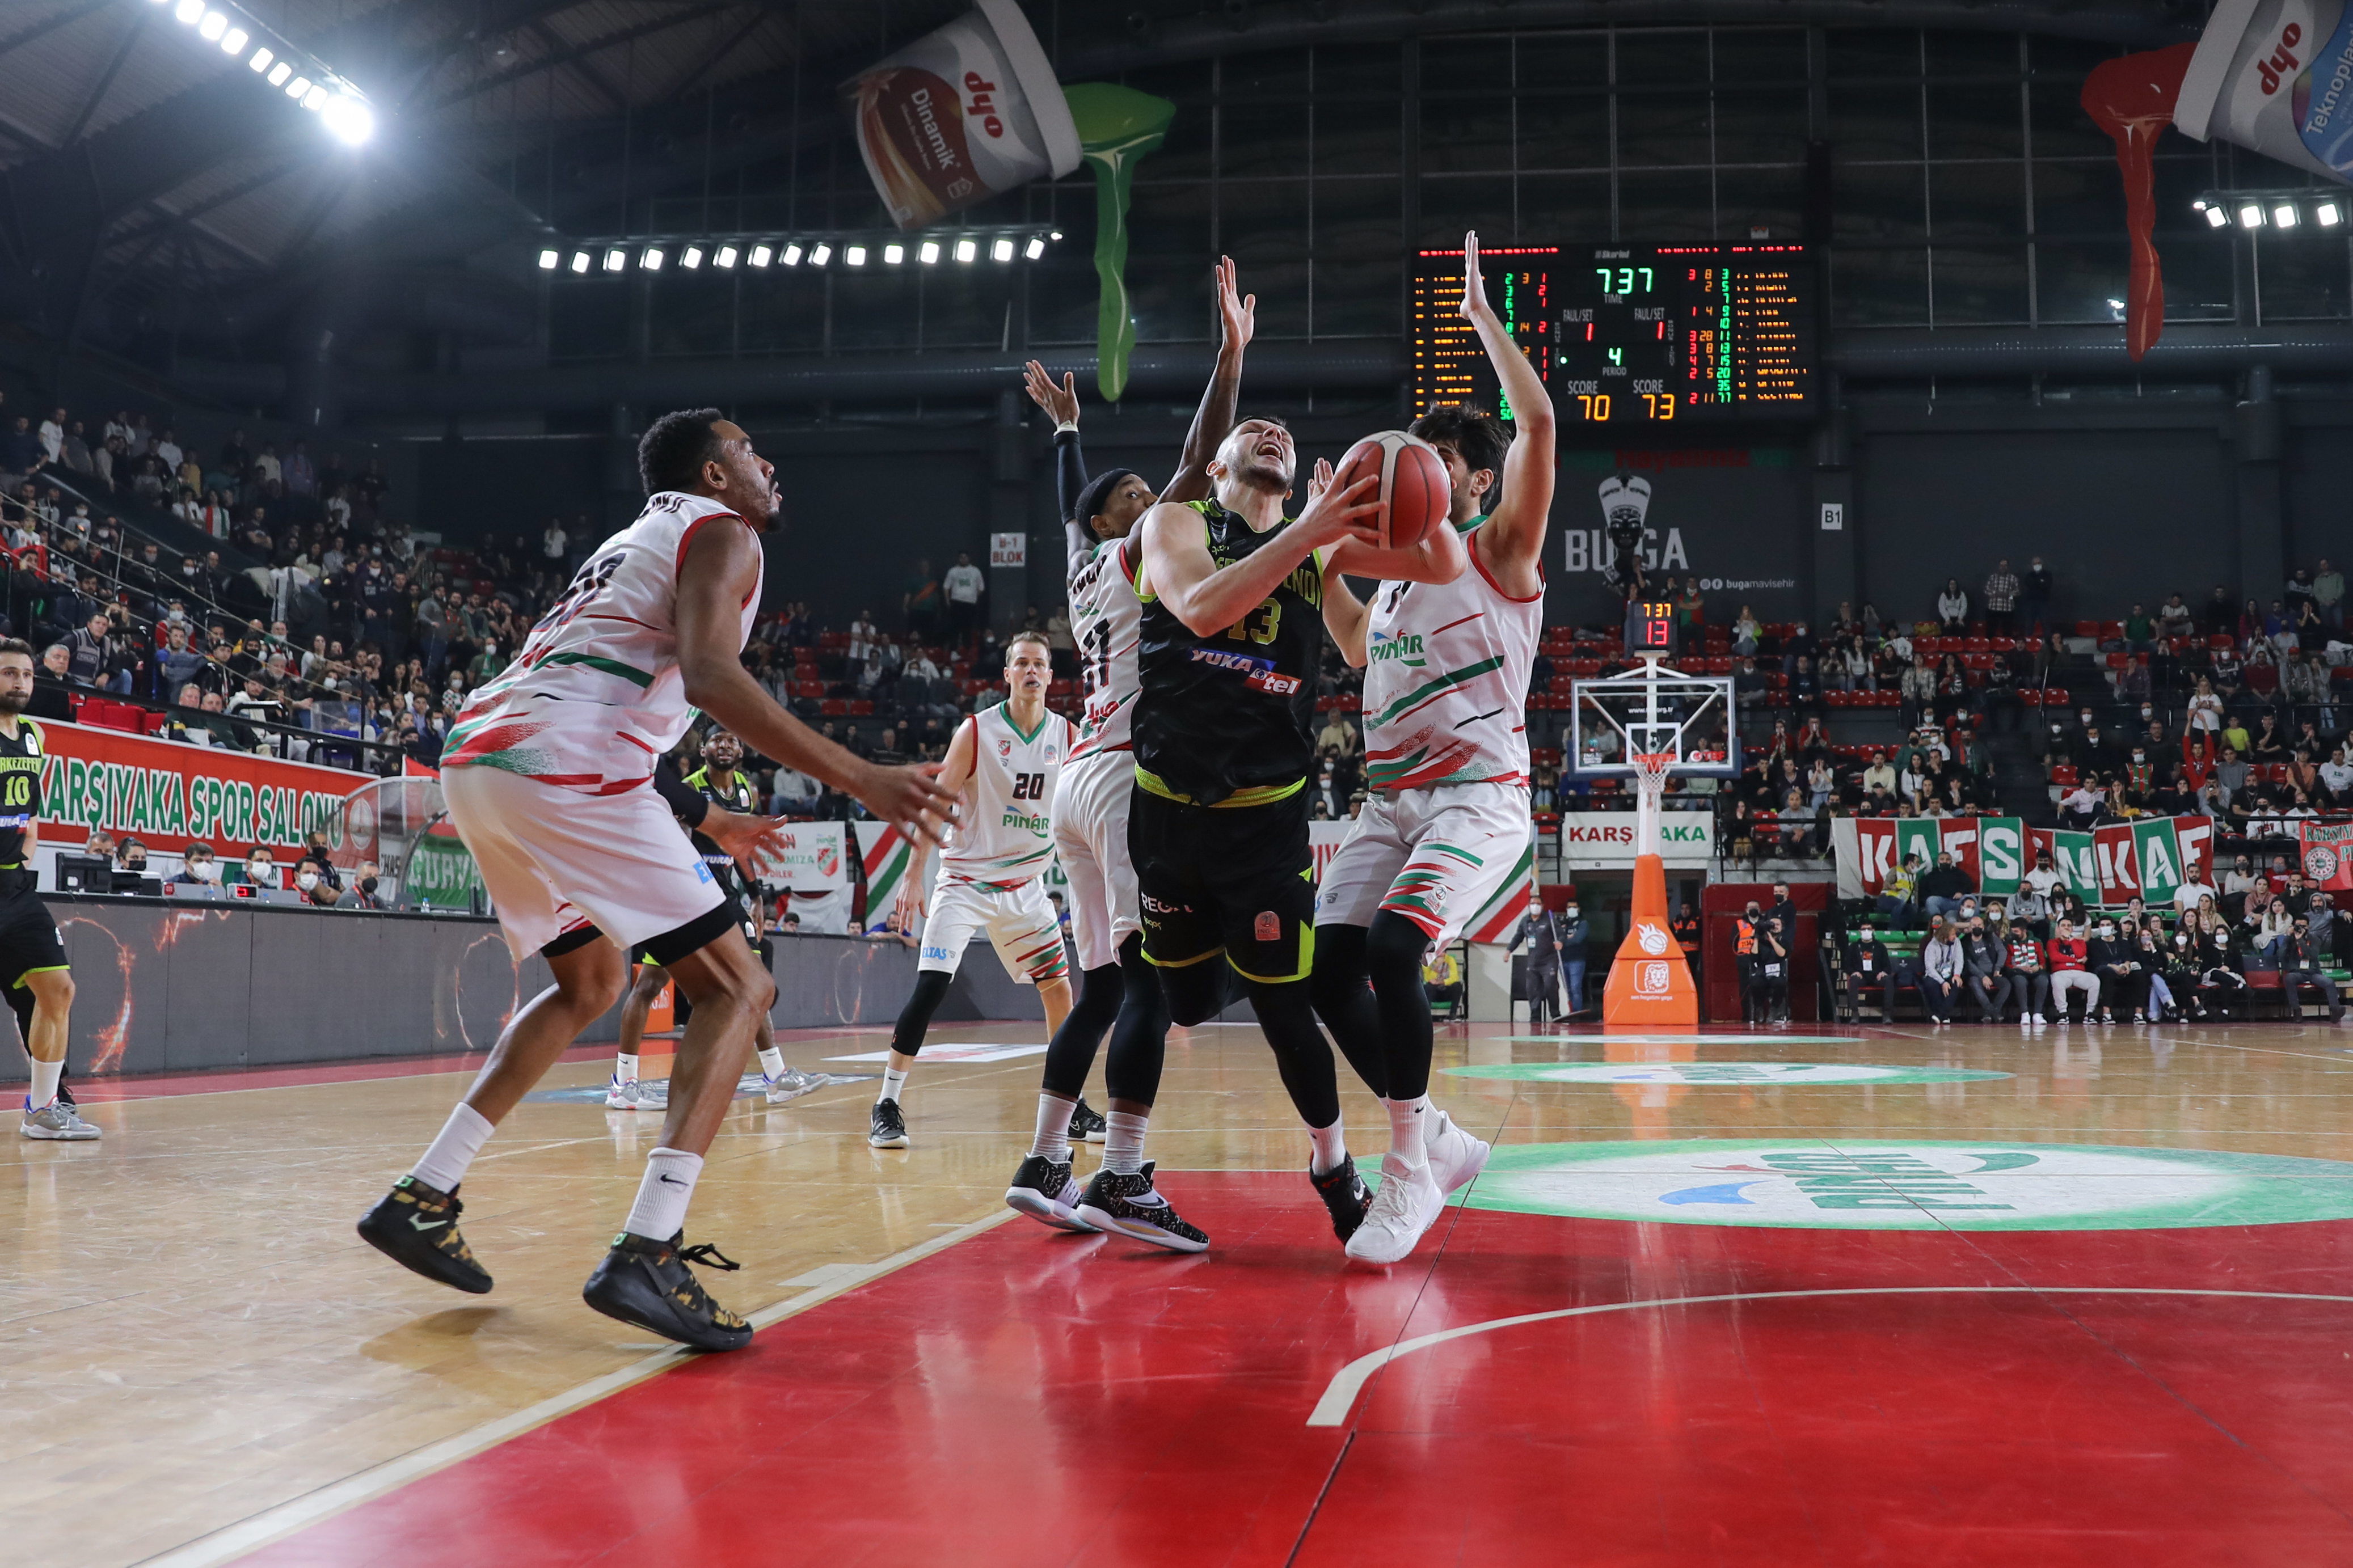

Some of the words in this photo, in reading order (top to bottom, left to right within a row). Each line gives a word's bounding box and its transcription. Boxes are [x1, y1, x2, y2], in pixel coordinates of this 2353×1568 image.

[2257, 23, 2301, 95] dyo
[965, 72, 1003, 138] dyo
[911, 87, 958, 171] Dinamik
[1688, 269, 1697, 281] 3
[1705, 269, 1712, 280] 8
[1722, 269, 1730, 280] 3
[1705, 281, 1713, 293] 2
[1604, 293, 1622, 303] TIME
[1723, 293, 1730, 304] 7
[1563, 309, 1593, 322] FAUL/SET
[1634, 307, 1665, 320] FAUL/SET
[1706, 306, 1713, 316] 4
[1586, 323, 1594, 341] 1
[1658, 322, 1664, 340] 1
[1689, 330, 1697, 342] 3
[1700, 330, 1713, 342] 28
[1689, 343, 1697, 354] 3
[1706, 343, 1713, 354] 8
[1609, 348, 1621, 366] 4
[1707, 355, 1713, 365] 7
[1603, 367, 1627, 376] PERIOD
[1689, 367, 1698, 379] 2
[1717, 367, 1730, 379] 20
[1567, 381, 1598, 395] SCORE
[1633, 379, 1664, 394] SCORE
[1689, 392, 1698, 404] 2
[1578, 395, 1610, 421] 70
[1642, 394, 1675, 420] 73
[1825, 511, 1840, 523] B1
[993, 552, 1023, 563] BLOK
[1647, 620, 1668, 645] 13
[1370, 633, 1425, 665] PINAR
[1191, 649, 1253, 671] YUKA
[1263, 675, 1298, 695] tel
[5, 775, 31, 806] 10
[1013, 773, 1045, 800] 20
[188, 775, 255, 843] SPOR
[256, 784, 344, 851] SALONU
[1002, 813, 1049, 830] PINAR
[2304, 825, 2353, 846] KARŞIY
